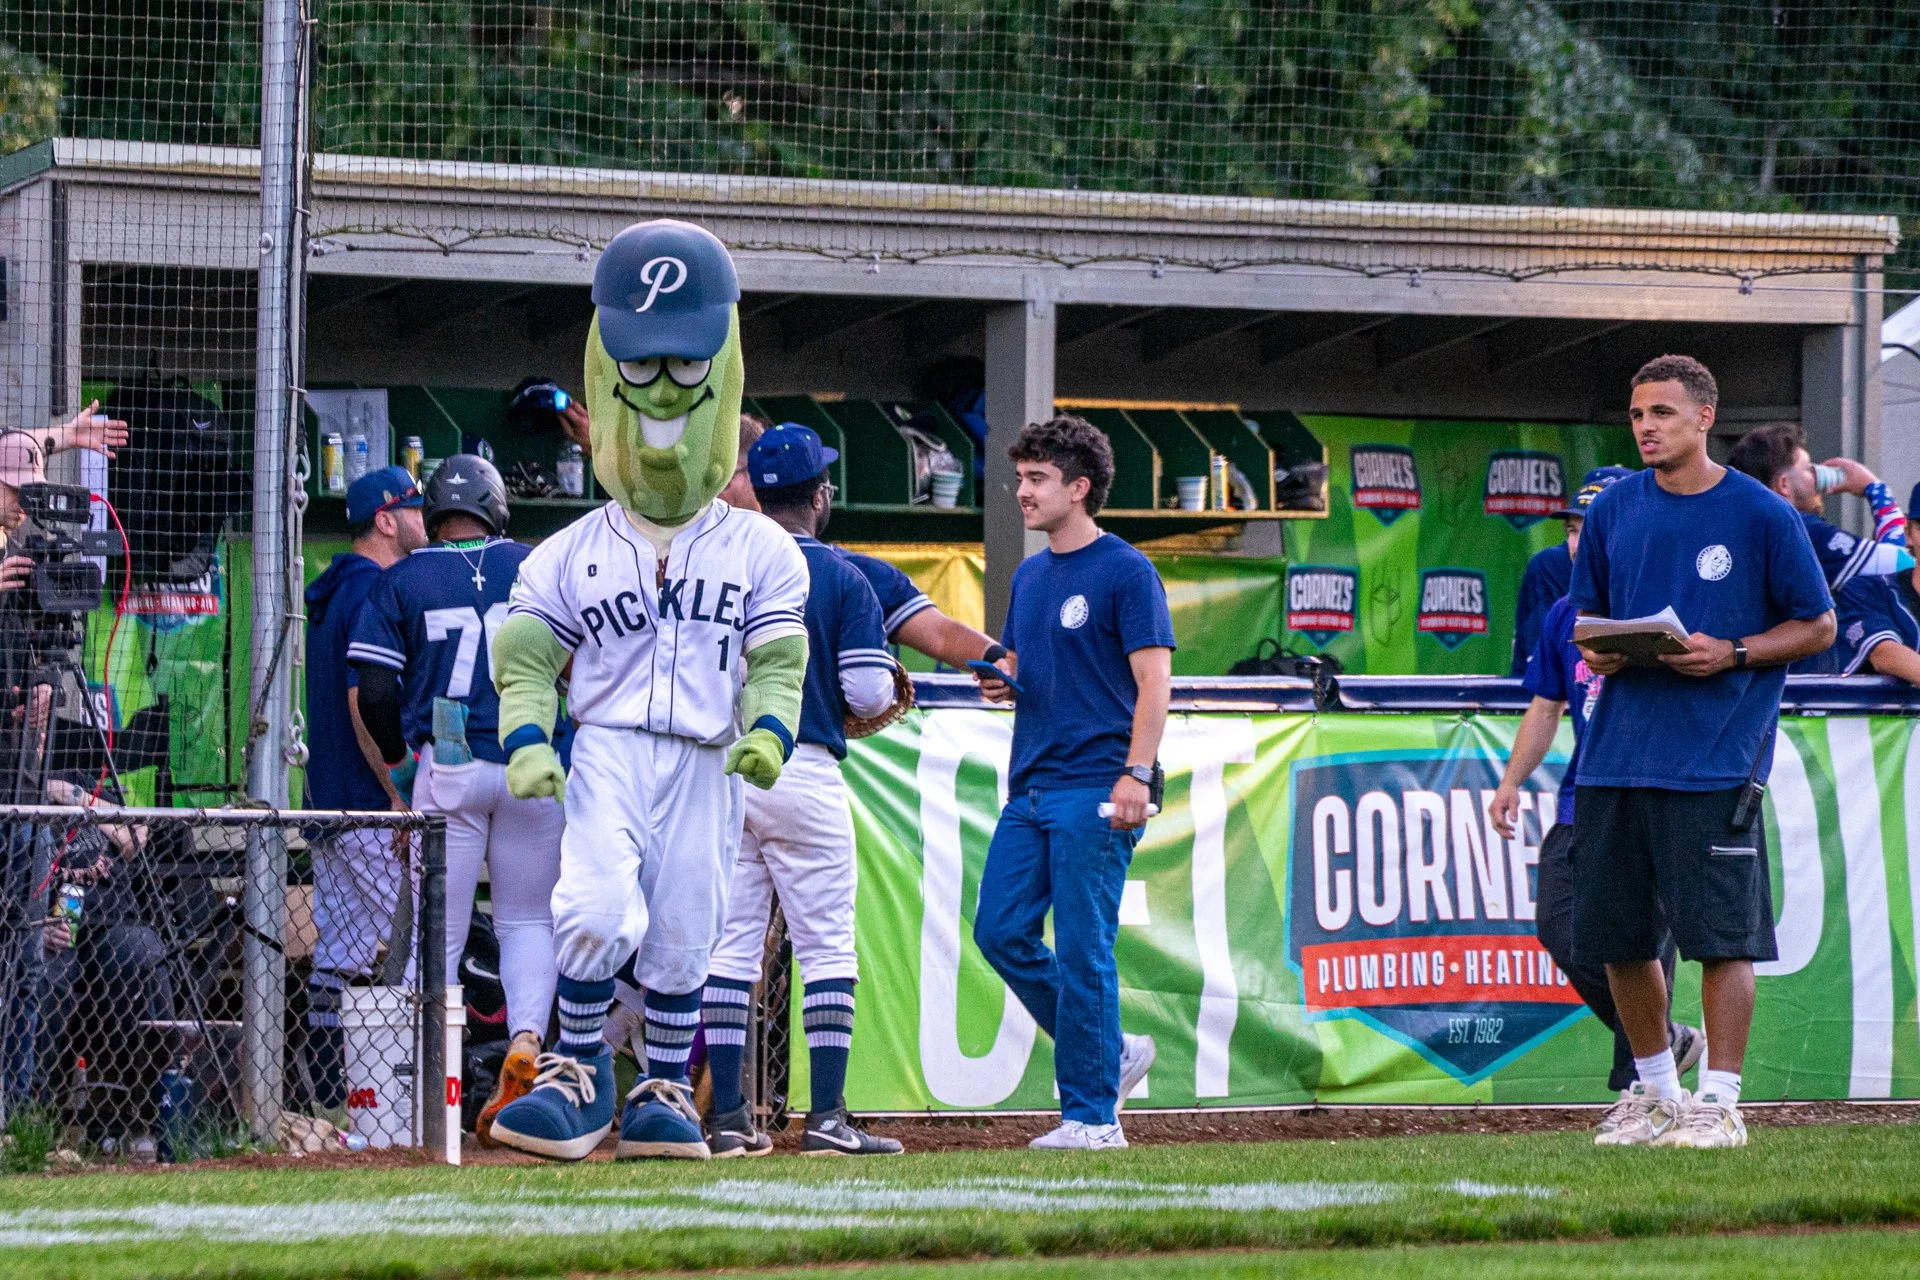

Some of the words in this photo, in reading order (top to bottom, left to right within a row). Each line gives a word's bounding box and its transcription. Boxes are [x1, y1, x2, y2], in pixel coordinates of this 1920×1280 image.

[635, 256, 688, 313] P
[717, 634, 730, 672] 1
[1312, 788, 1558, 932] CORNE
[1318, 950, 1446, 995] PLUMBING
[1473, 1017, 1504, 1045] 1982
